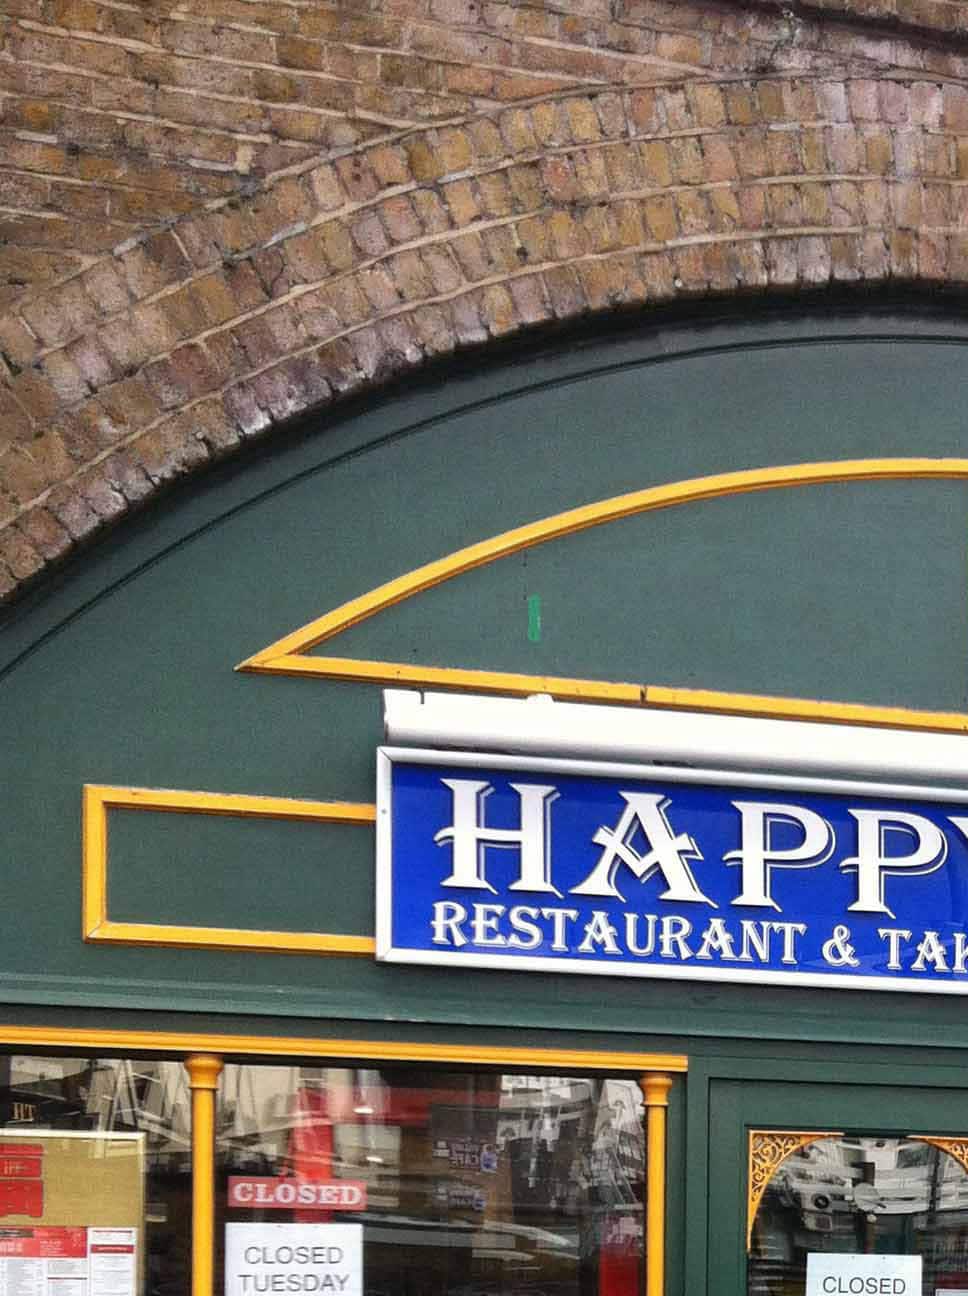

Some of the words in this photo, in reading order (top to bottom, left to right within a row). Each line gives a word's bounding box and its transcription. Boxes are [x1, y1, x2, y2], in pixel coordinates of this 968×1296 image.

[431, 900, 808, 965] RESTAURANT
[822, 924, 860, 968] &
[233, 1182, 362, 1205] CLOSED
[244, 1246, 344, 1264] CLOSED
[237, 1274, 350, 1292] TUESDAY
[822, 1276, 906, 1295] CLOSED
